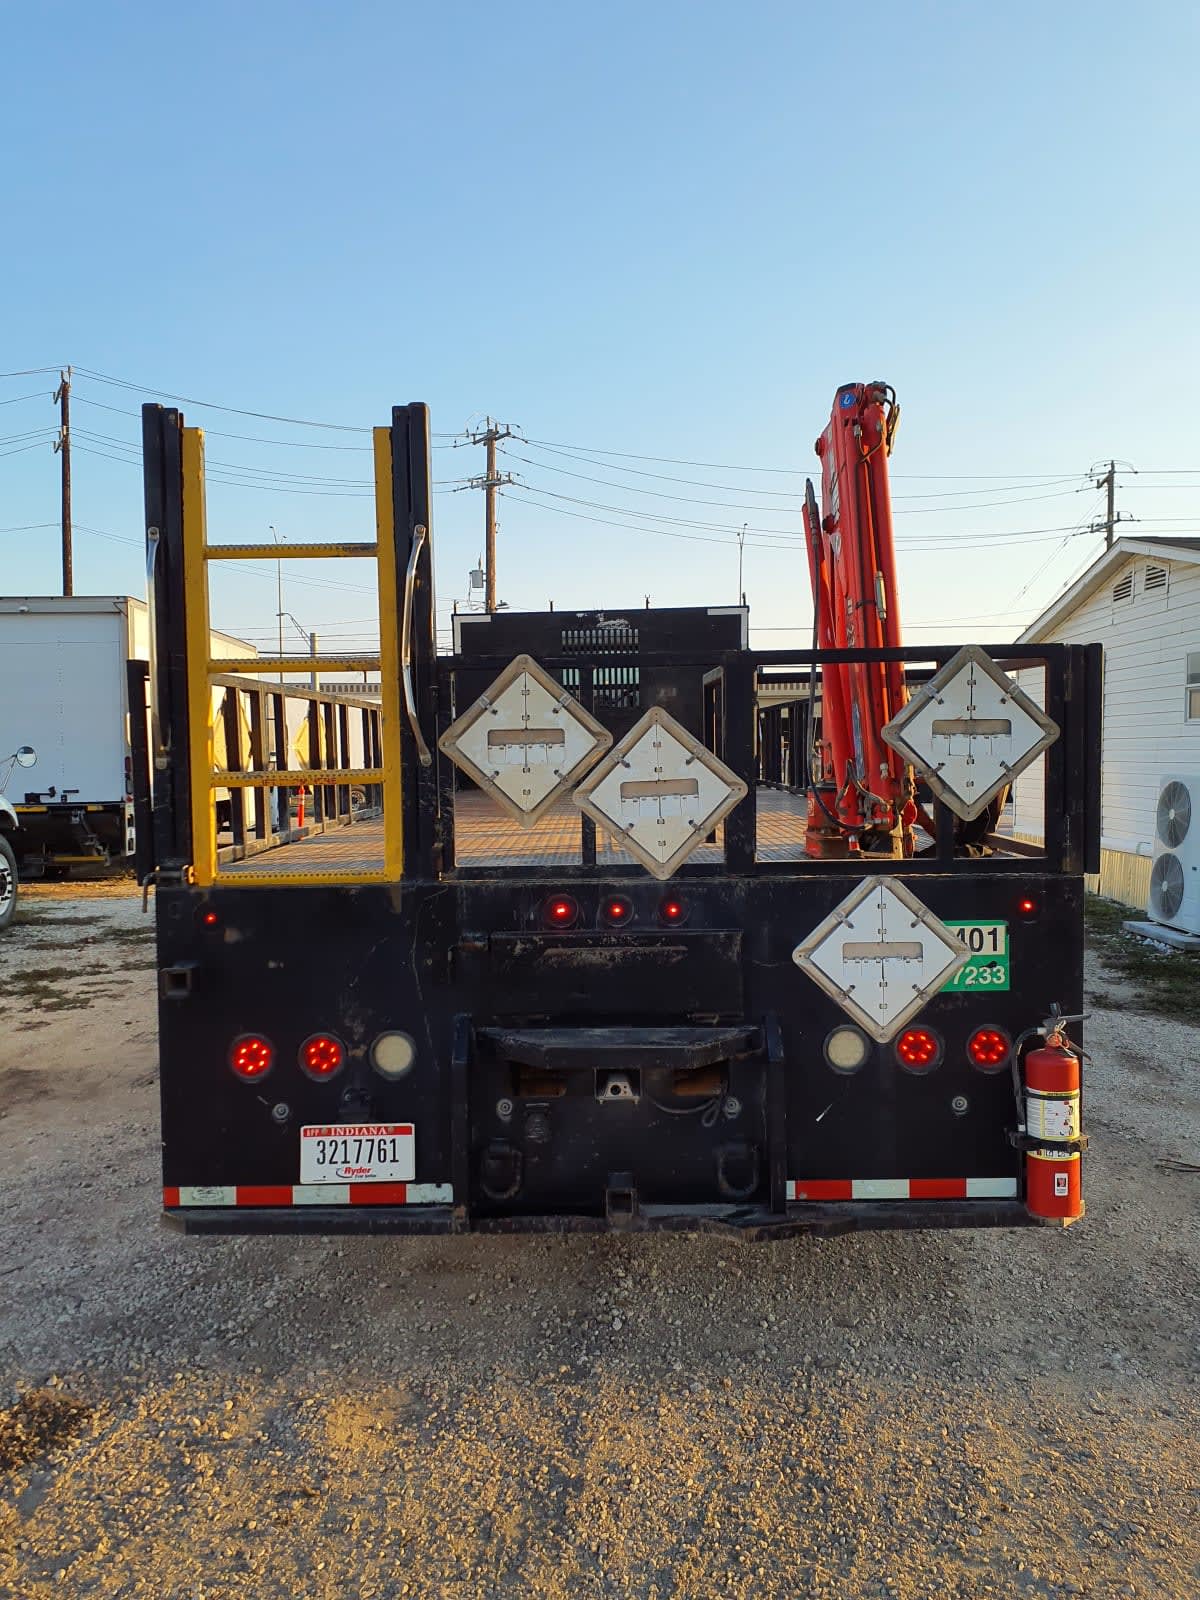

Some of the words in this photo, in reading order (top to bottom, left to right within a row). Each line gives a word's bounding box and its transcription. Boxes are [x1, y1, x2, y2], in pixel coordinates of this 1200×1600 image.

[331, 1127, 388, 1136] INDIANA
[316, 1138, 399, 1165] 3217761
[344, 1166, 371, 1176] Ryder
